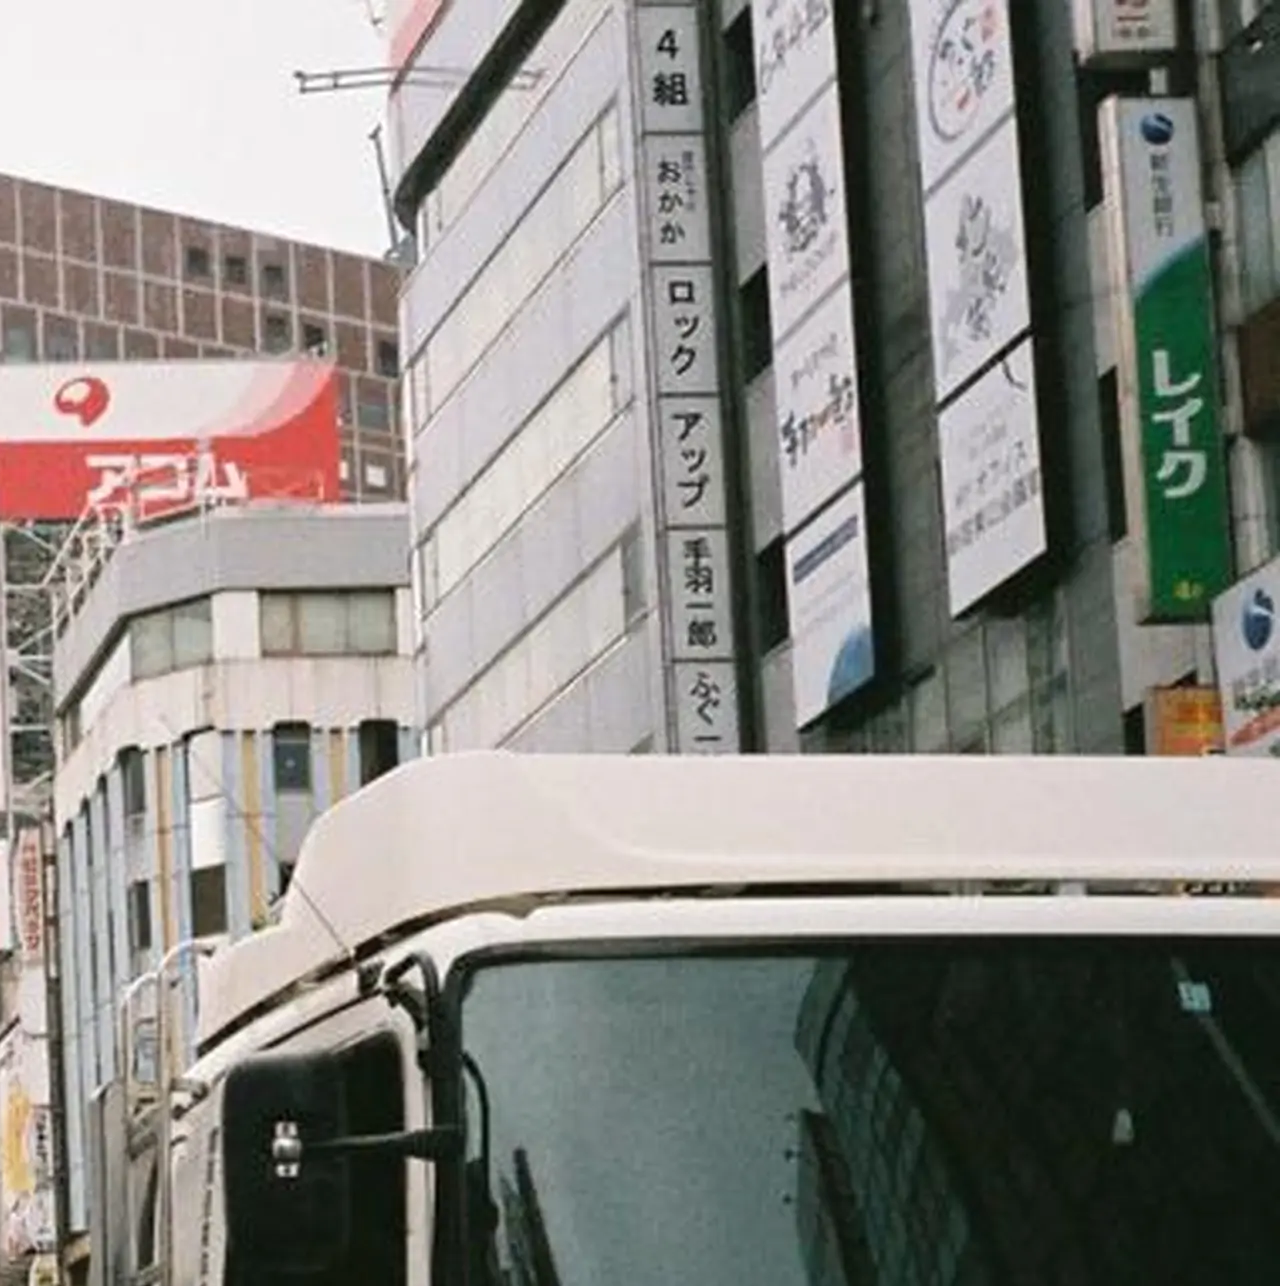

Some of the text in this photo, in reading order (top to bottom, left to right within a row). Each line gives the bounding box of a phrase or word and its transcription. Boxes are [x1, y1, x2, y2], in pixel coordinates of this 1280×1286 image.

[653, 29, 686, 106] 4組
[657, 160, 685, 244] おかか
[668, 280, 699, 376] ロック
[1152, 350, 1207, 498] レイク
[85, 454, 249, 502] アコム
